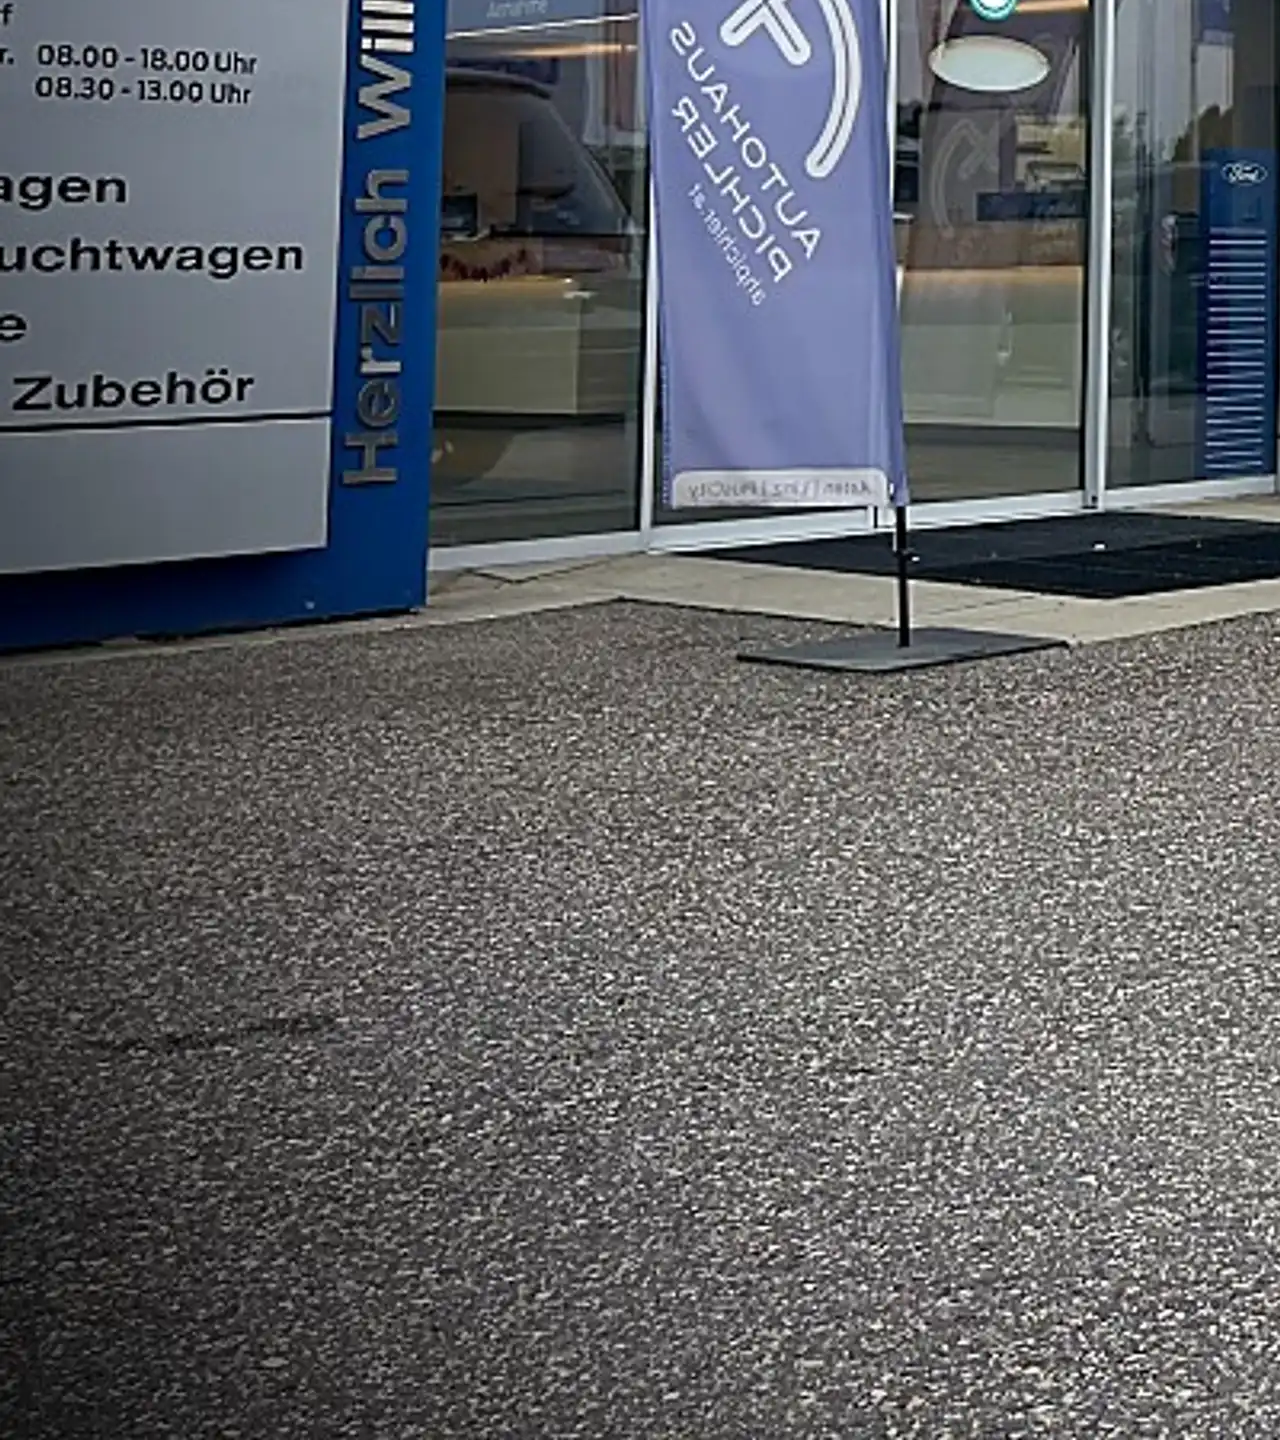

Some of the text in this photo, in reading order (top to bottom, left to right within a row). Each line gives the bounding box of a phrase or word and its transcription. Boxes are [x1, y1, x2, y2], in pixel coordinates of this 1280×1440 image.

[38, 44, 118, 68] 08.00
[141, 48, 209, 72] 18.00
[215, 51, 257, 74] Uhr
[36, 76, 114, 100] 08.30
[138, 79, 203, 102] 13.00
[211, 83, 252, 103] Uhr
[0, 237, 303, 279] uchtwagen
[342, 169, 409, 485] Herzlich
[12, 368, 254, 410] Zubehör
